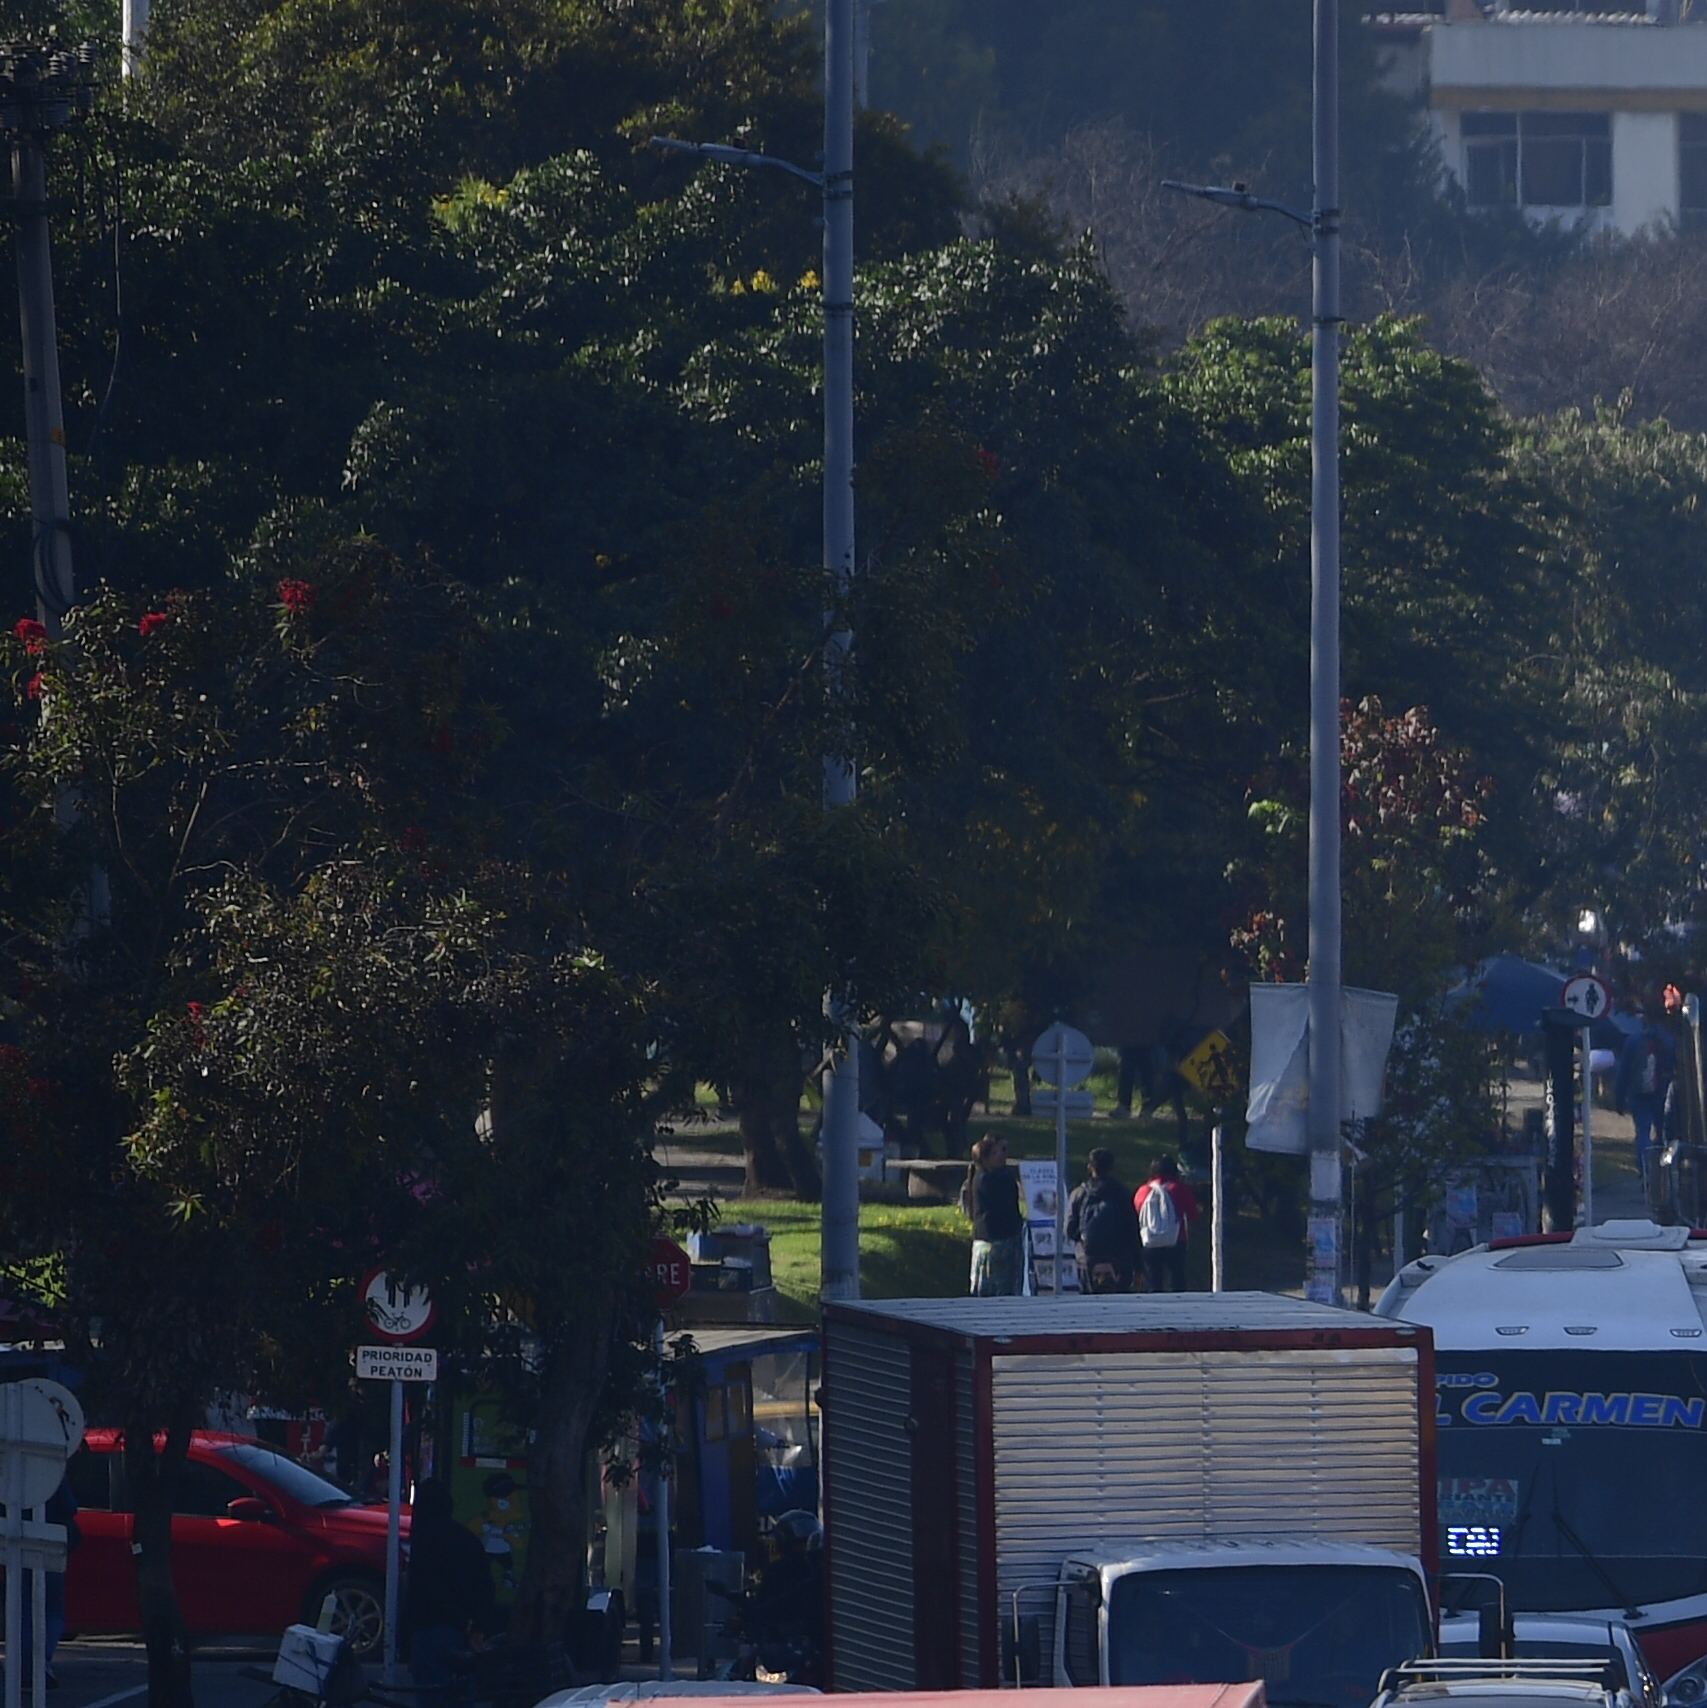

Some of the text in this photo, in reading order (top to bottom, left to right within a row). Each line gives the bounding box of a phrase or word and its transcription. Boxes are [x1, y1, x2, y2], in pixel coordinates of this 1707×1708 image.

[655, 1262, 681, 1286] RE
[362, 1350, 433, 1363] PRIORIDAD
[370, 1365, 422, 1378] PEATÓN
[1436, 1372, 1500, 1389] PIDO
[1436, 1391, 1706, 1428] L CARMEN
[1441, 1479, 1514, 1494] IPA
